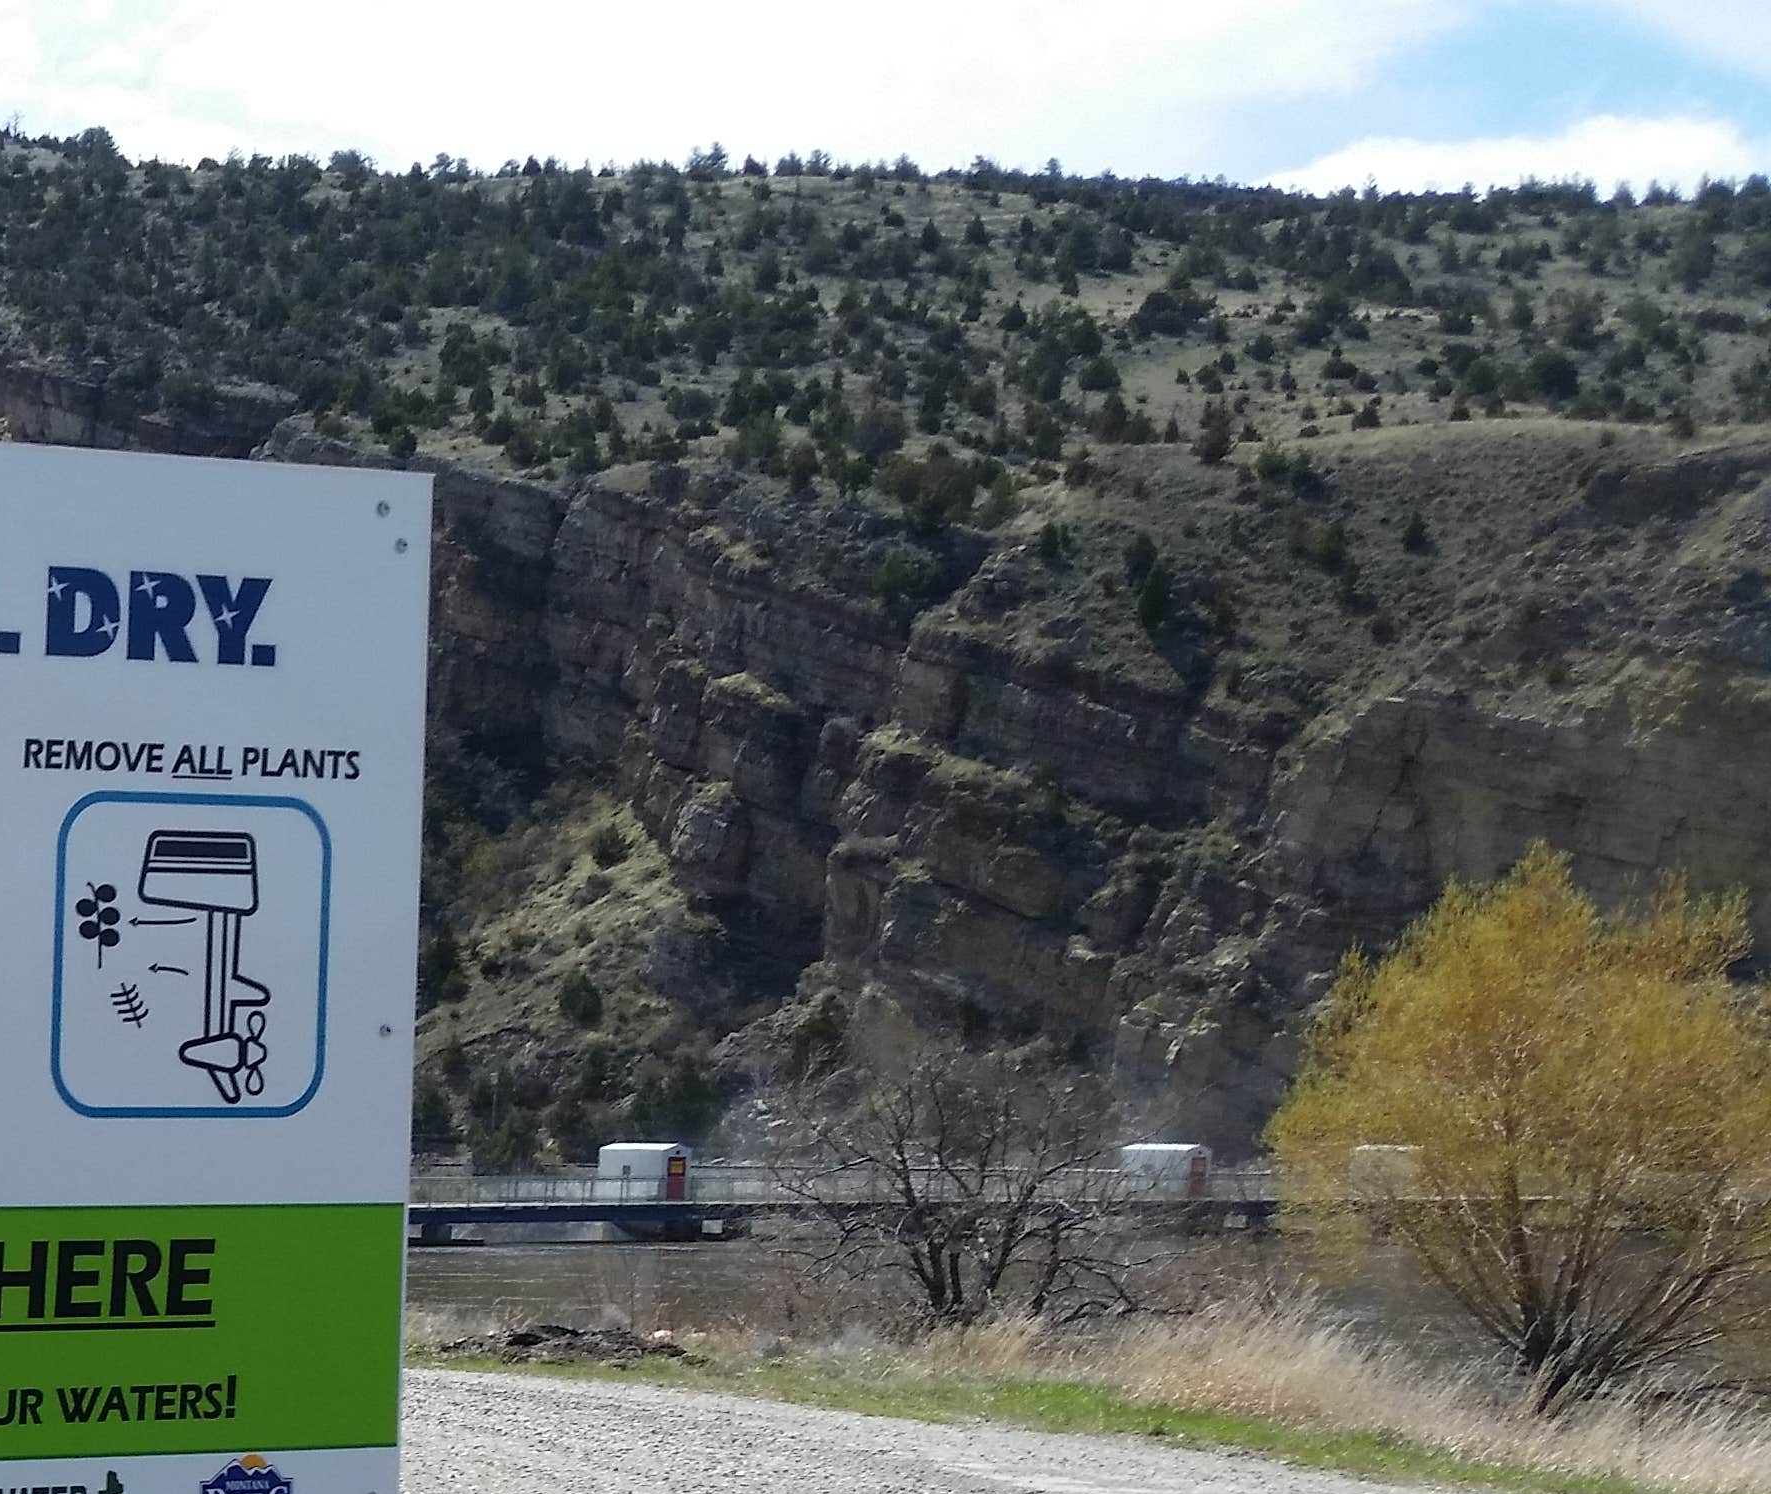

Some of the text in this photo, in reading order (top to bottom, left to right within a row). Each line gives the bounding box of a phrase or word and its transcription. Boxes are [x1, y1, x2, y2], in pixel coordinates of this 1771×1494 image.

[45, 565, 277, 667] DRY.
[22, 737, 362, 781] REMOVE ALL PLANTS
[55, 1374, 238, 1425] WATERS!
